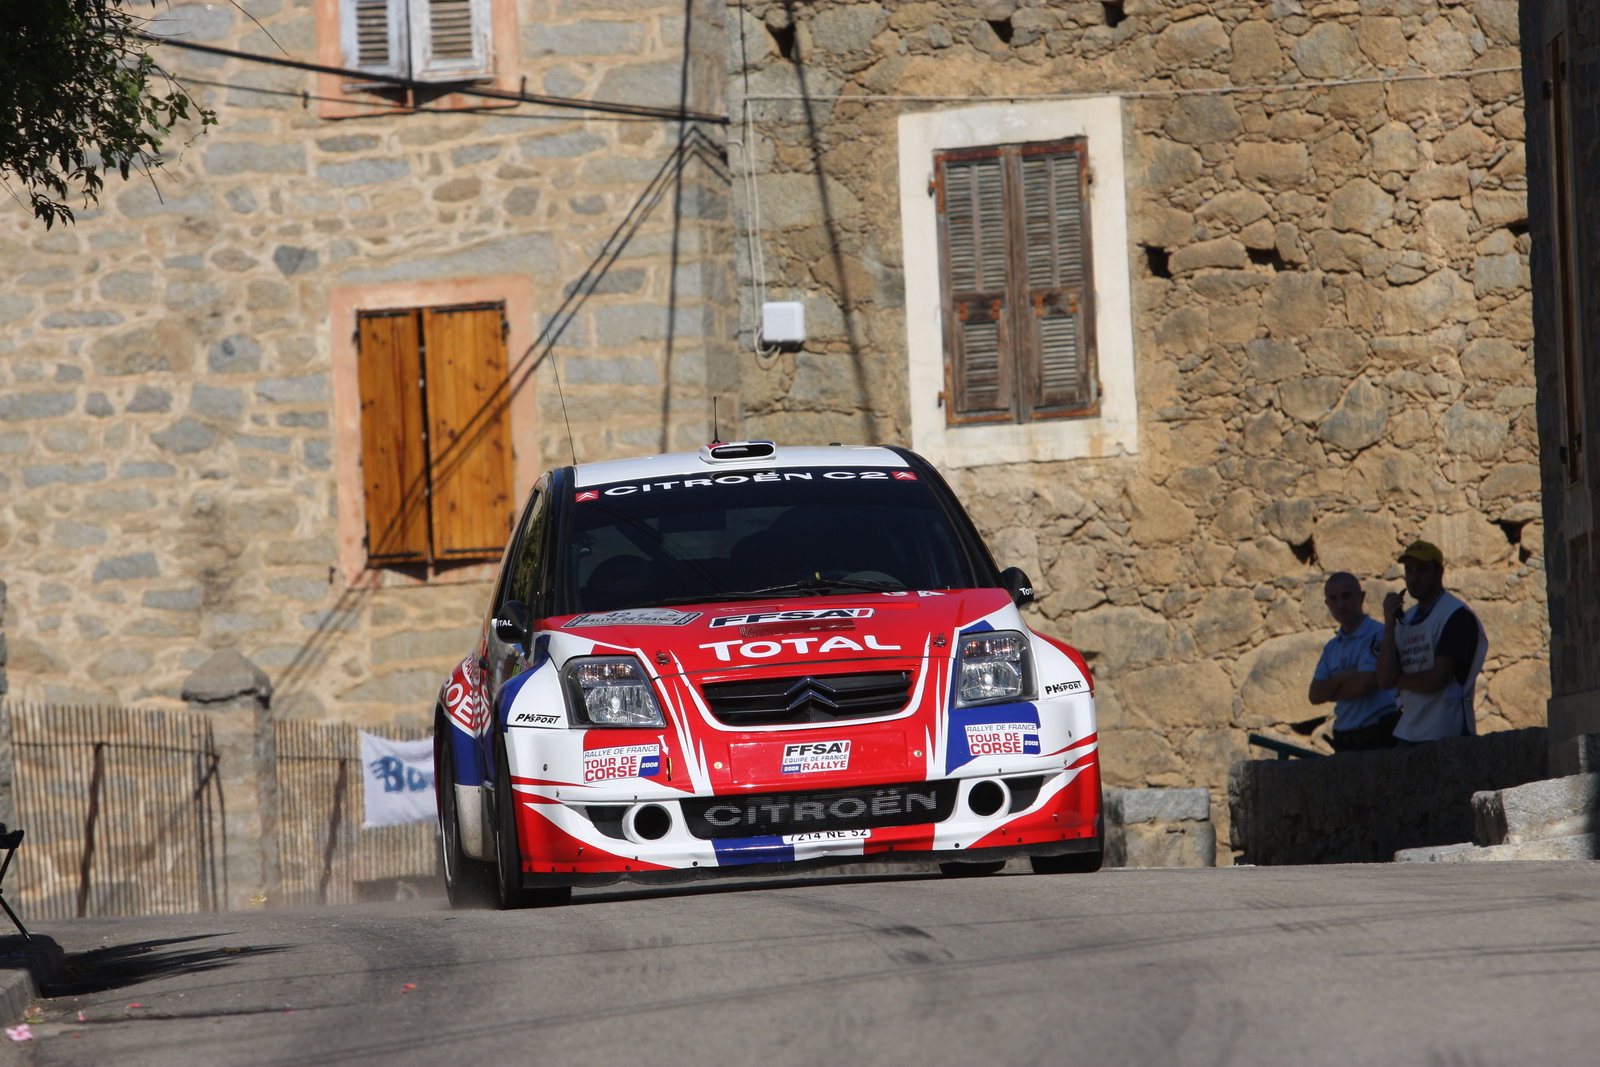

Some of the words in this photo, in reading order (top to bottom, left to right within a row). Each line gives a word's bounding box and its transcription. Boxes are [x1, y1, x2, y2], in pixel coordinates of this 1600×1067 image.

[604, 471, 813, 496] CITROËN
[822, 471, 889, 480] C2
[712, 609, 853, 627] FFSA
[699, 635, 901, 661] TOTAL
[966, 724, 994, 732] RALLYE
[1008, 723, 1036, 731] FRANCE
[968, 733, 1001, 743] TOUR
[1005, 732, 1021, 742] DE
[584, 749, 612, 759] RALLYE
[613, 747, 624, 755] DE
[626, 745, 658, 754] FRANCE
[786, 742, 842, 757] FFSA
[970, 741, 1022, 755] CORSE
[584, 757, 616, 770] TOUR
[621, 755, 637, 766] DE
[802, 760, 847, 771] RALLYE
[585, 765, 637, 782] CORSE
[703, 789, 937, 826] CITROËN
[826, 830, 846, 839] NE
[851, 829, 867, 837] 52
